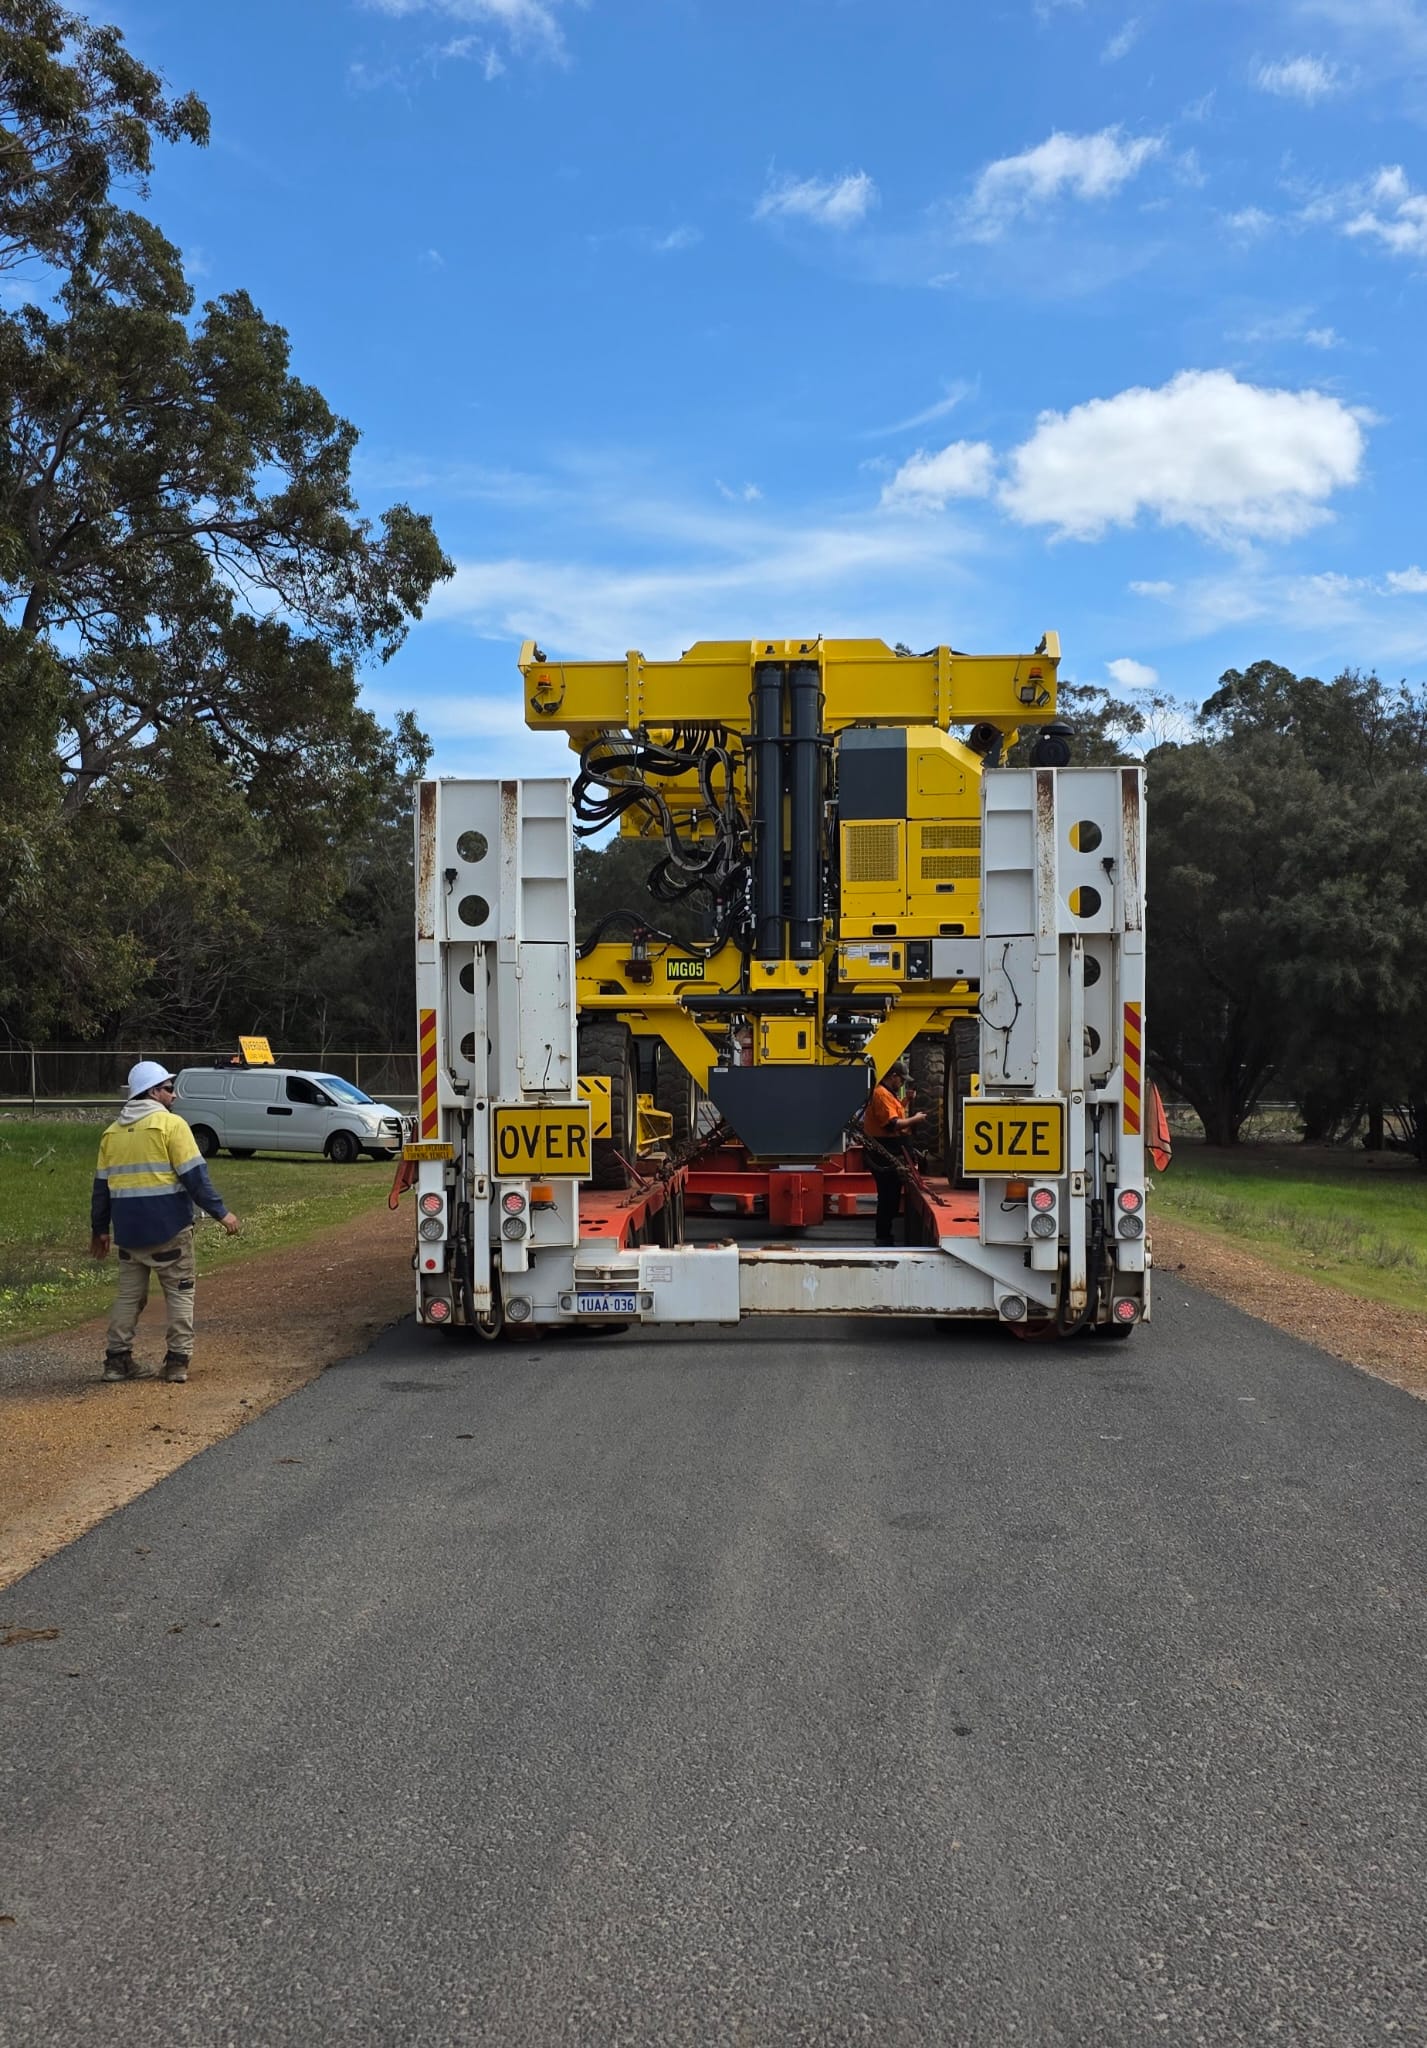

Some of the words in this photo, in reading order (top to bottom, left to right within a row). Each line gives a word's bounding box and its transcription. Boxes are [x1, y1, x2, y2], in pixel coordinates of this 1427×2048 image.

[668, 962, 704, 977] MG05
[499, 1125, 586, 1160] OVER
[974, 1120, 1050, 1156] SIZE
[430, 1152, 449, 1160] VEHICLE
